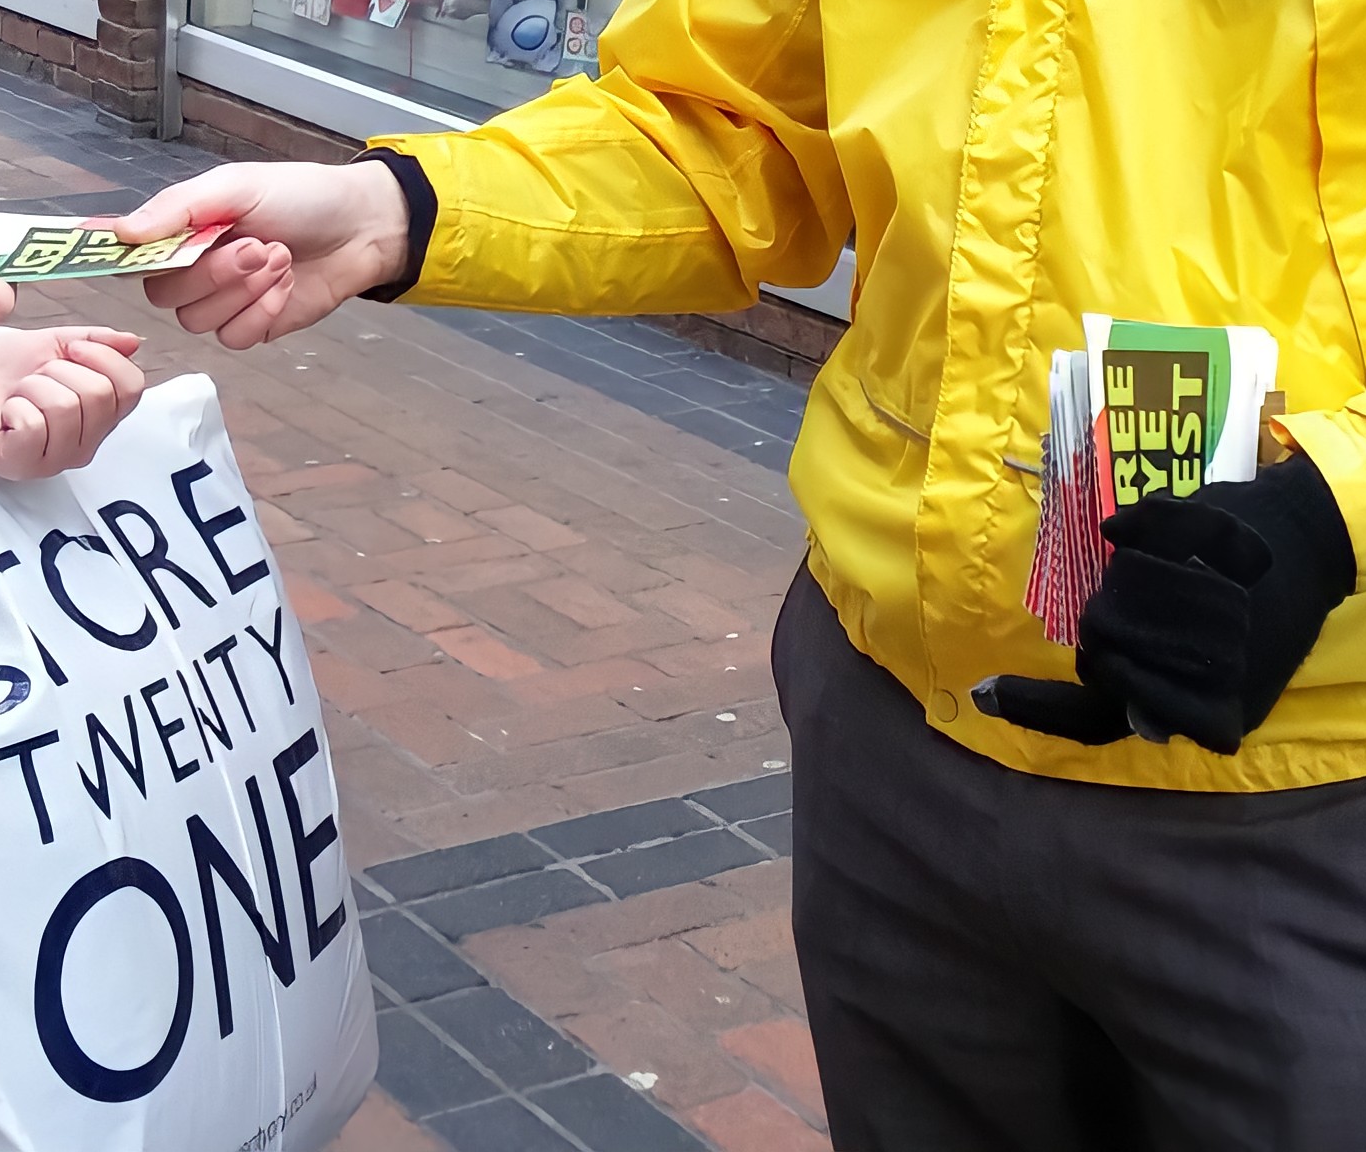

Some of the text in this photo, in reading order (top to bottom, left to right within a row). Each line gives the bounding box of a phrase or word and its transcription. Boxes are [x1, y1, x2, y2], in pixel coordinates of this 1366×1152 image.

[1107, 365, 1139, 506] REE
[1171, 363, 1203, 498] EST
[34, 728, 347, 1103] ONE
